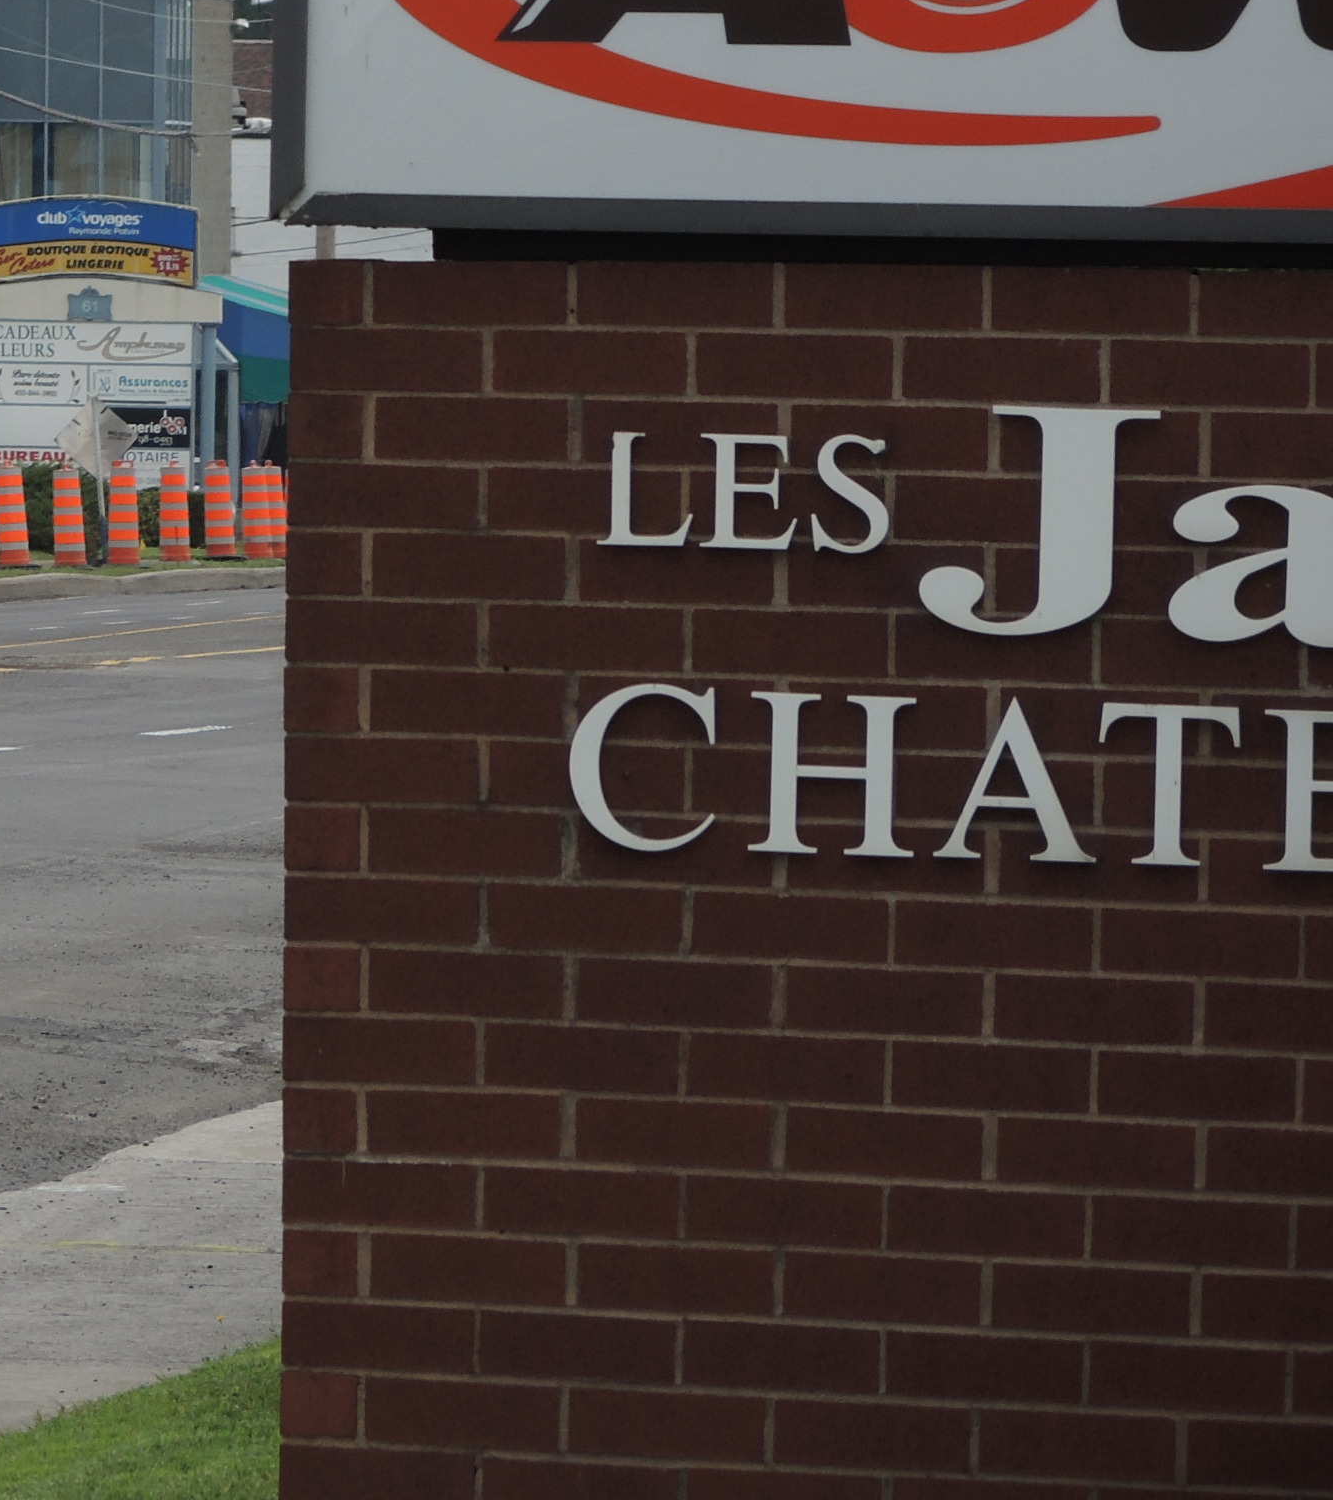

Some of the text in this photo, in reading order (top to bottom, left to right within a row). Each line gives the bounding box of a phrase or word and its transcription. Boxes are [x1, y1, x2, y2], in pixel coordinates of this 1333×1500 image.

[36, 211, 141, 227] club voyages
[26, 242, 151, 257] BOUTIQUE ÉROTIQUE
[66, 259, 124, 270] LINGERIE
[118, 375, 189, 388] Assurances
[122, 451, 180, 463] OTAIRE
[596, 405, 1333, 649] LES Ja
